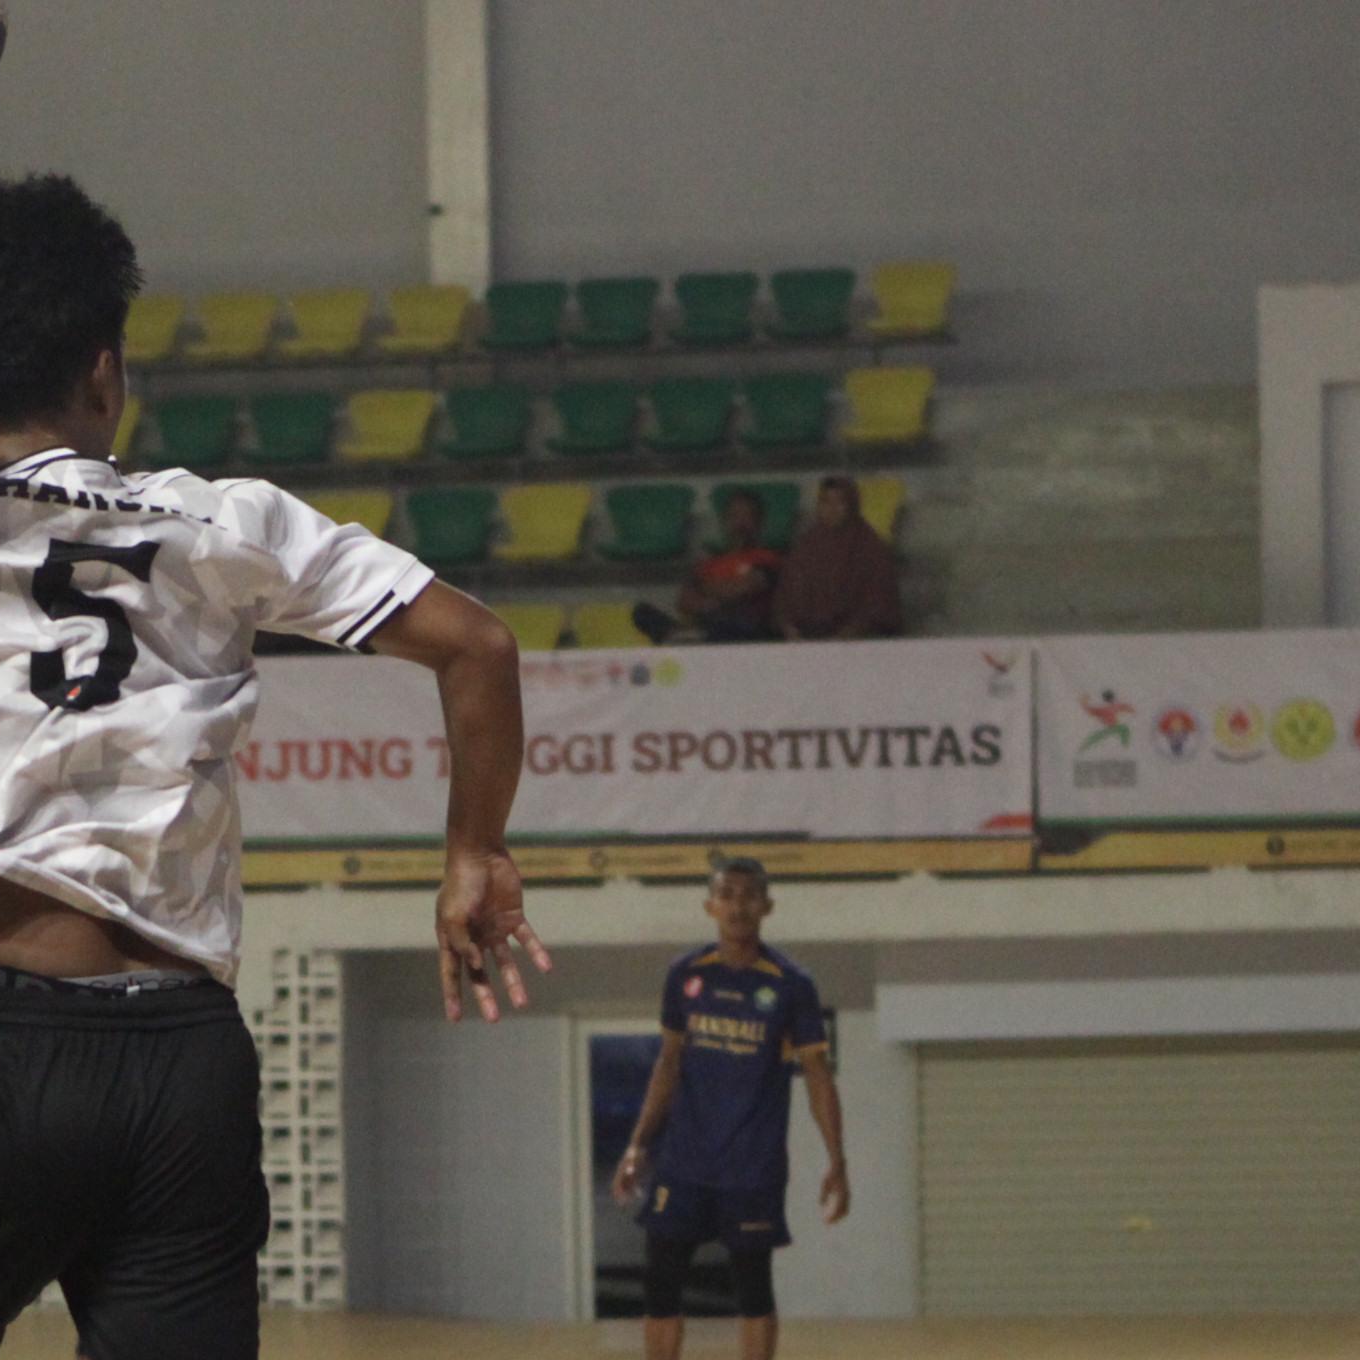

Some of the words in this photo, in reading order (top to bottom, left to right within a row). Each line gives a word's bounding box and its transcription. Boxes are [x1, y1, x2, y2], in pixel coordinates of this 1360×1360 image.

[30, 538, 162, 712] 5
[425, 732, 616, 778] TGGI
[631, 724, 1003, 774] SPORTIVITAS
